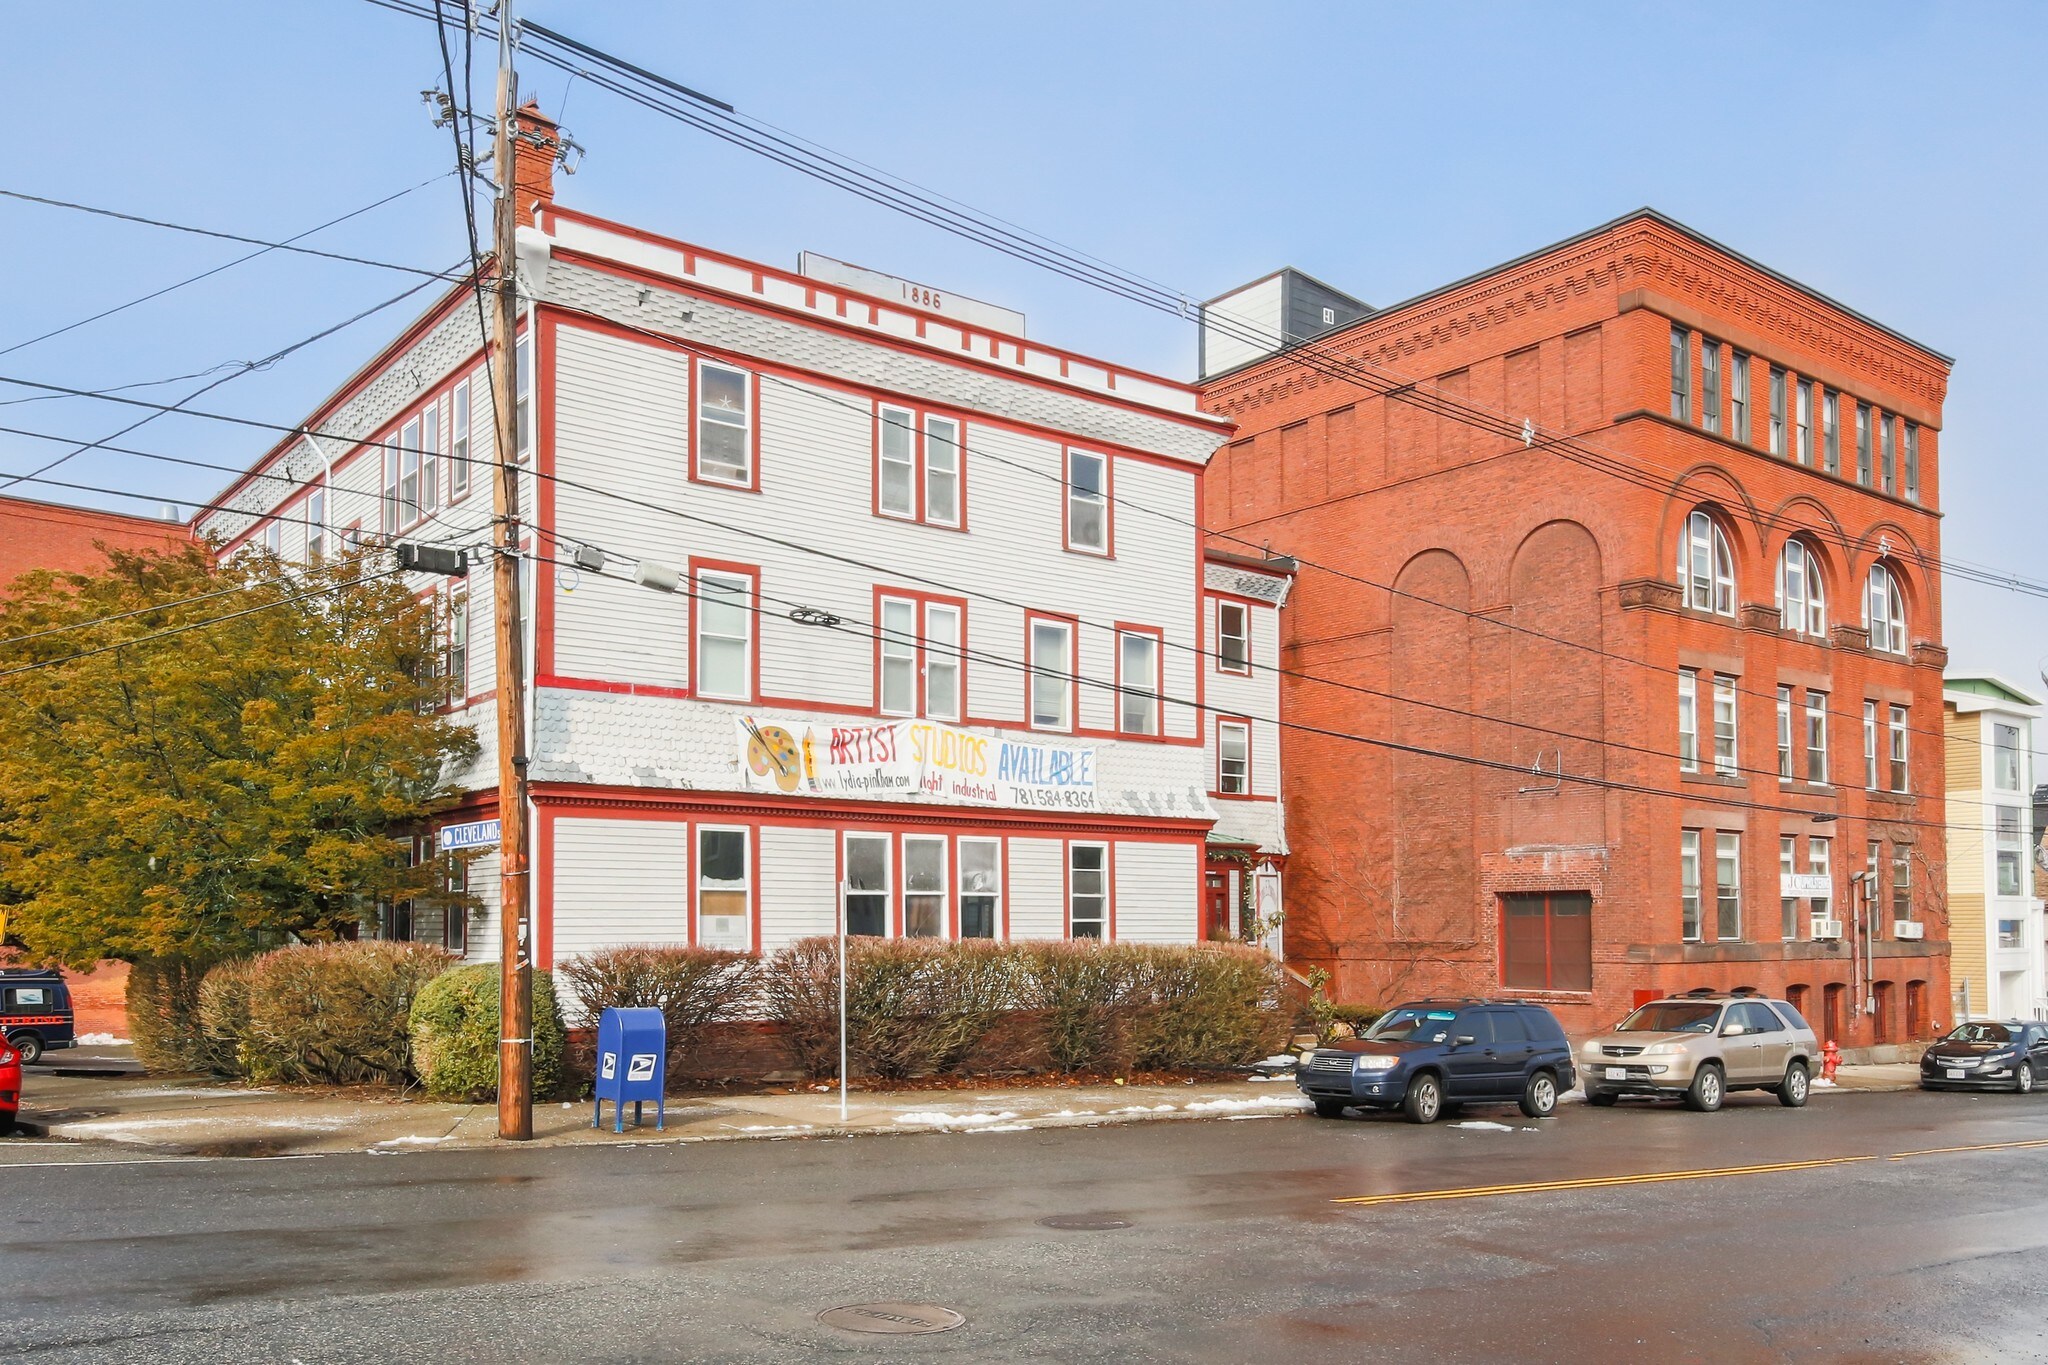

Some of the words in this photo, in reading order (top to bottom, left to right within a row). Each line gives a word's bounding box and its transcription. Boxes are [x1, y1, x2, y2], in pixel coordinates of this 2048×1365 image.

[902, 282, 941, 308] 1886
[829, 724, 898, 766] ARTIST
[909, 723, 989, 778] STUDIOS
[997, 742, 1094, 787] AVAILABLE
[952, 777, 998, 802] industrial
[454, 823, 497, 844] CLEVELAND
